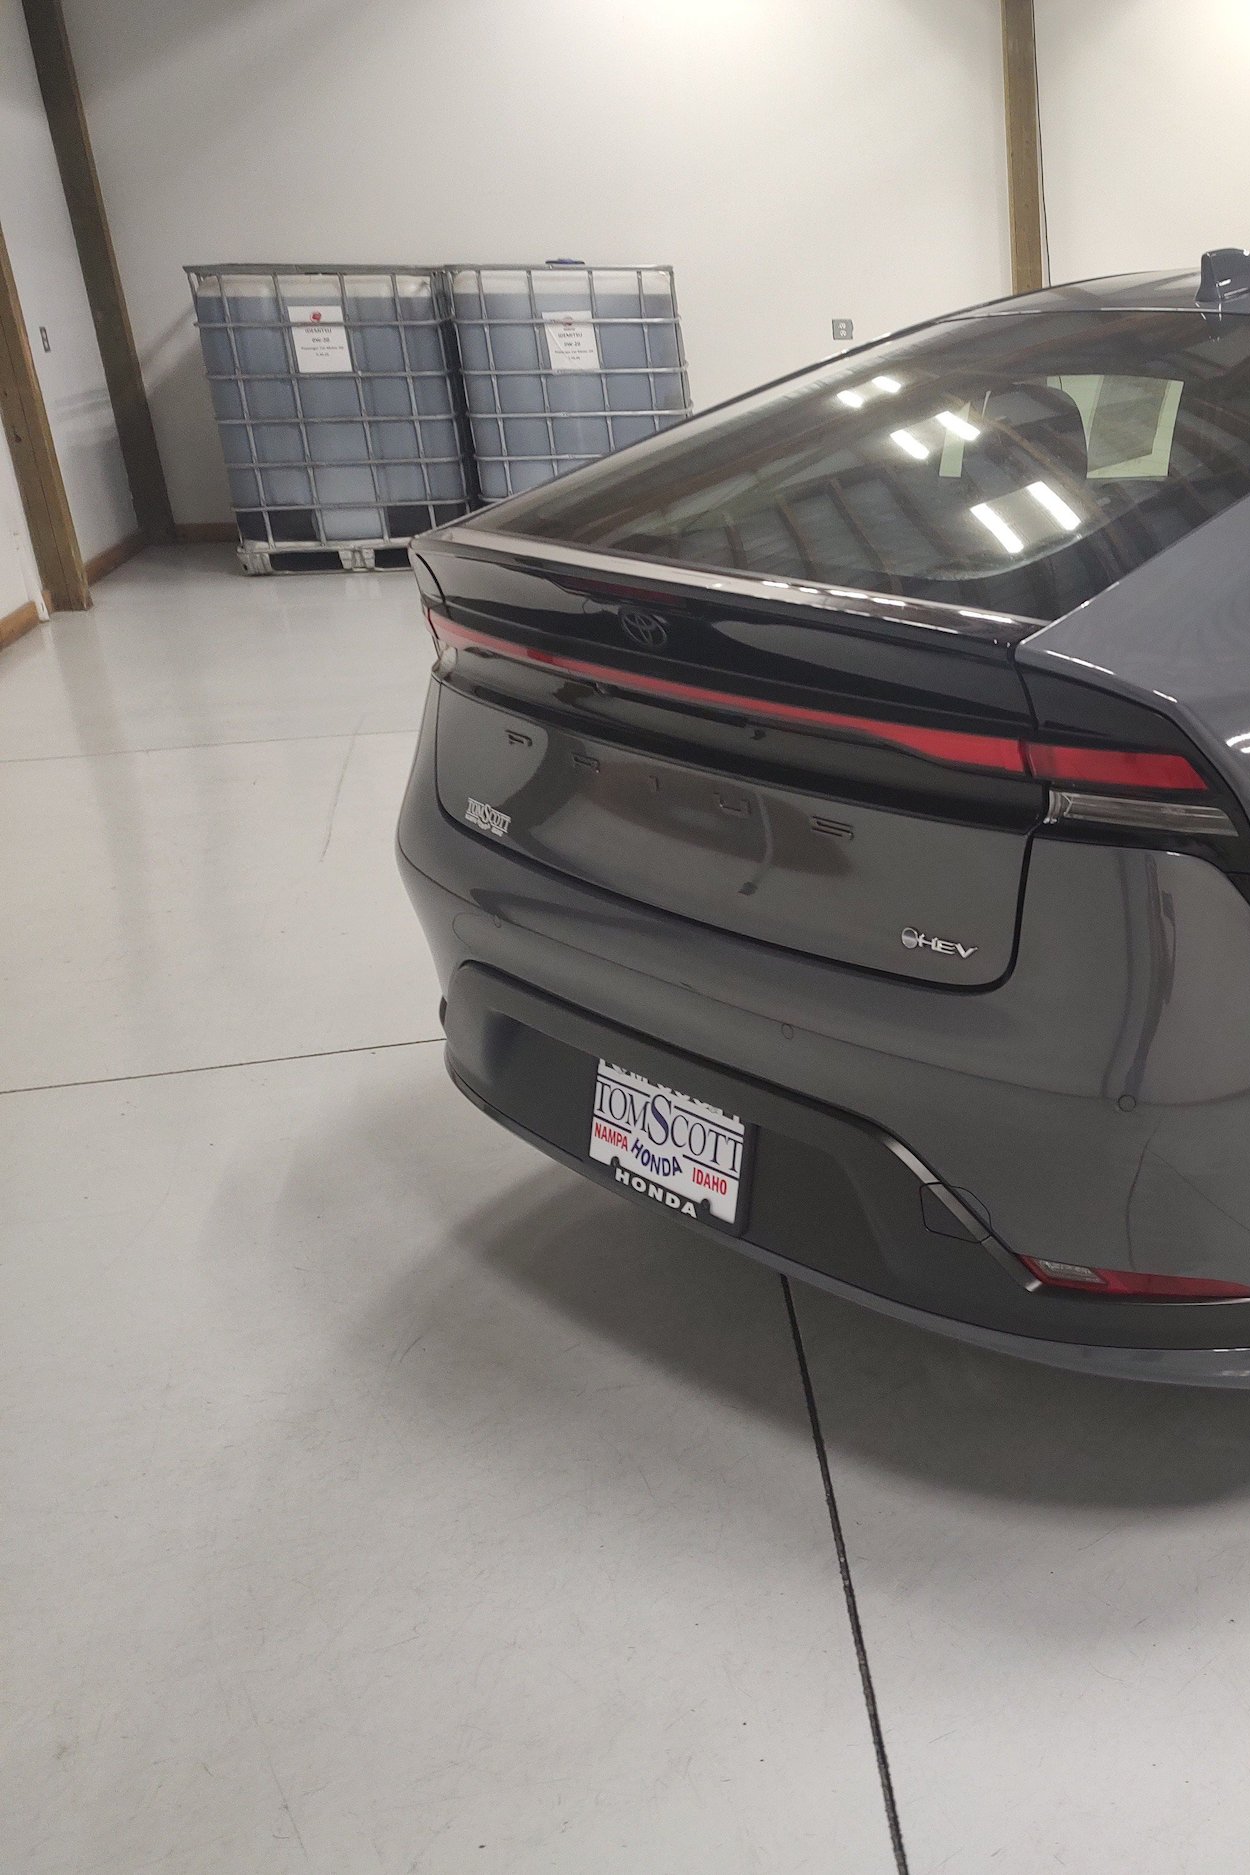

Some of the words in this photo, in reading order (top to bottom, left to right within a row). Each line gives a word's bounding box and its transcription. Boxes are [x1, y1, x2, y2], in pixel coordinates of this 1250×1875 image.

[594, 1122, 629, 1152] NAMPA
[630, 1137, 683, 1177] HONDA
[614, 1168, 698, 1219] HONDA
[691, 1167, 728, 1196] IDAHO
